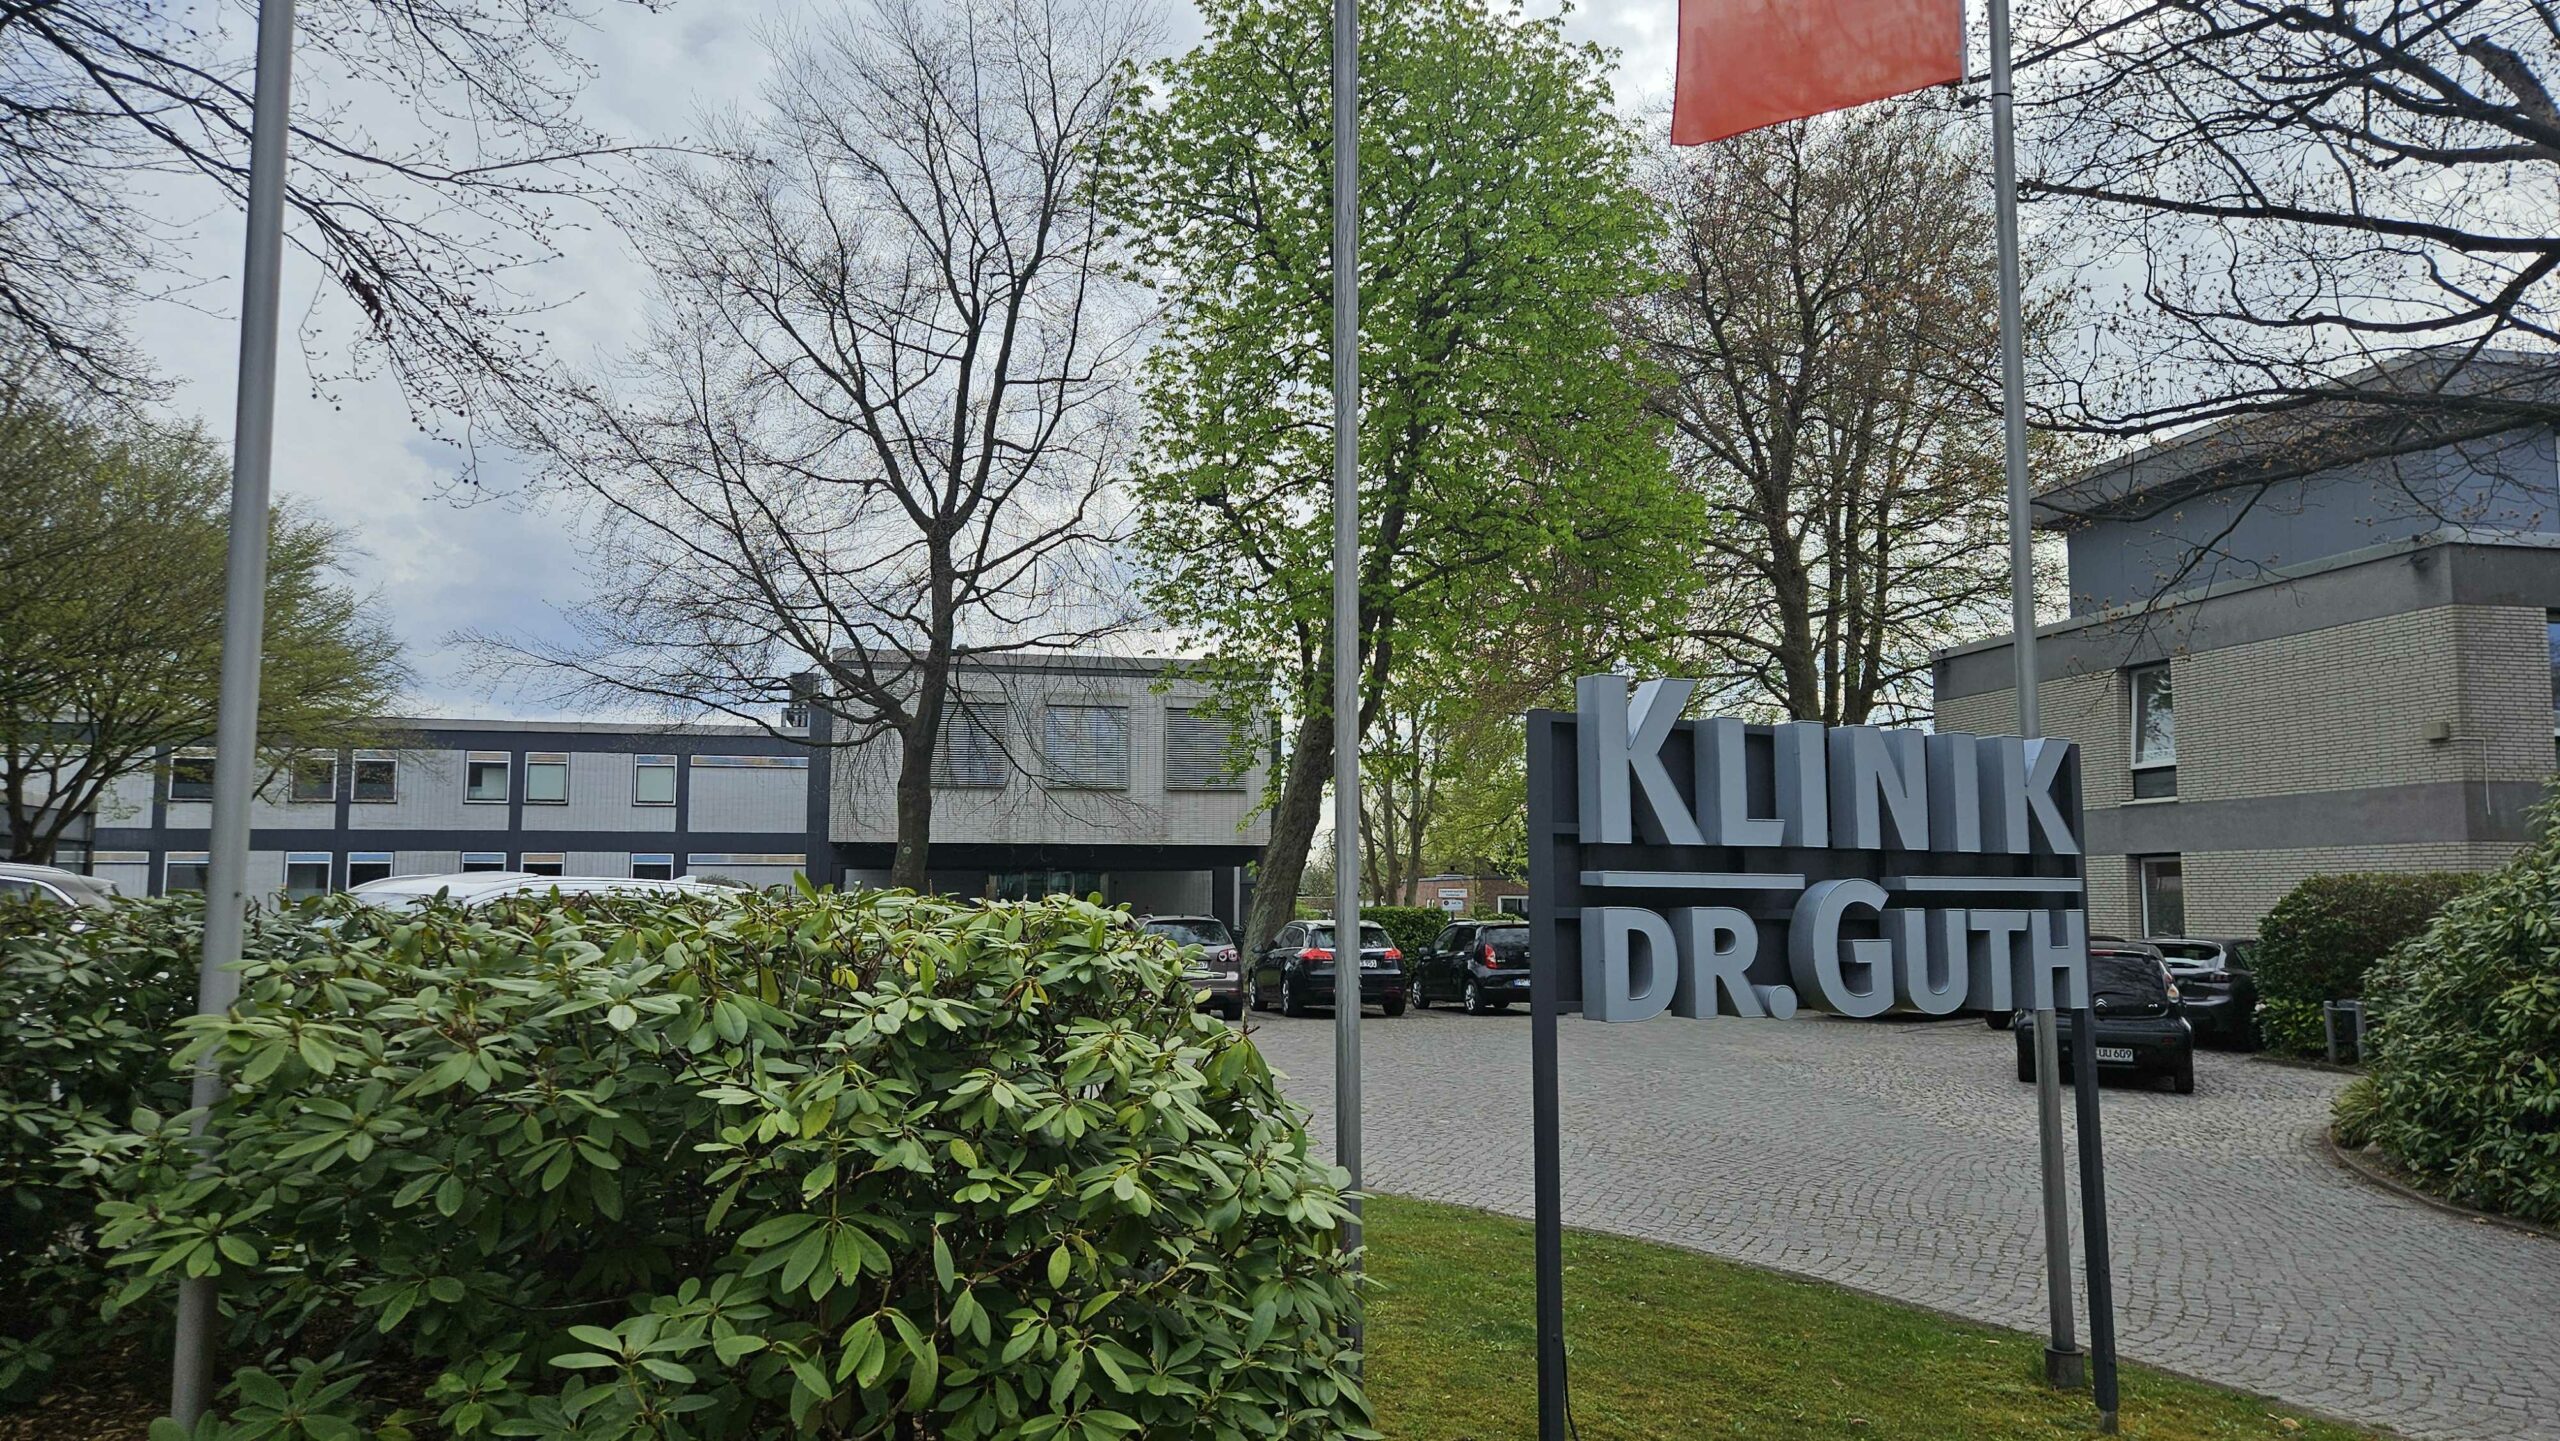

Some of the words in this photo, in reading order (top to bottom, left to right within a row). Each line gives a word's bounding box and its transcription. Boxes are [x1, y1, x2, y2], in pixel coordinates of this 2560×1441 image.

[1576, 673, 2081, 855] KLINIK
[1580, 906, 1798, 1023] DR.
[1788, 877, 2089, 1019] GUTH
[2113, 1049, 2132, 1059] 609
